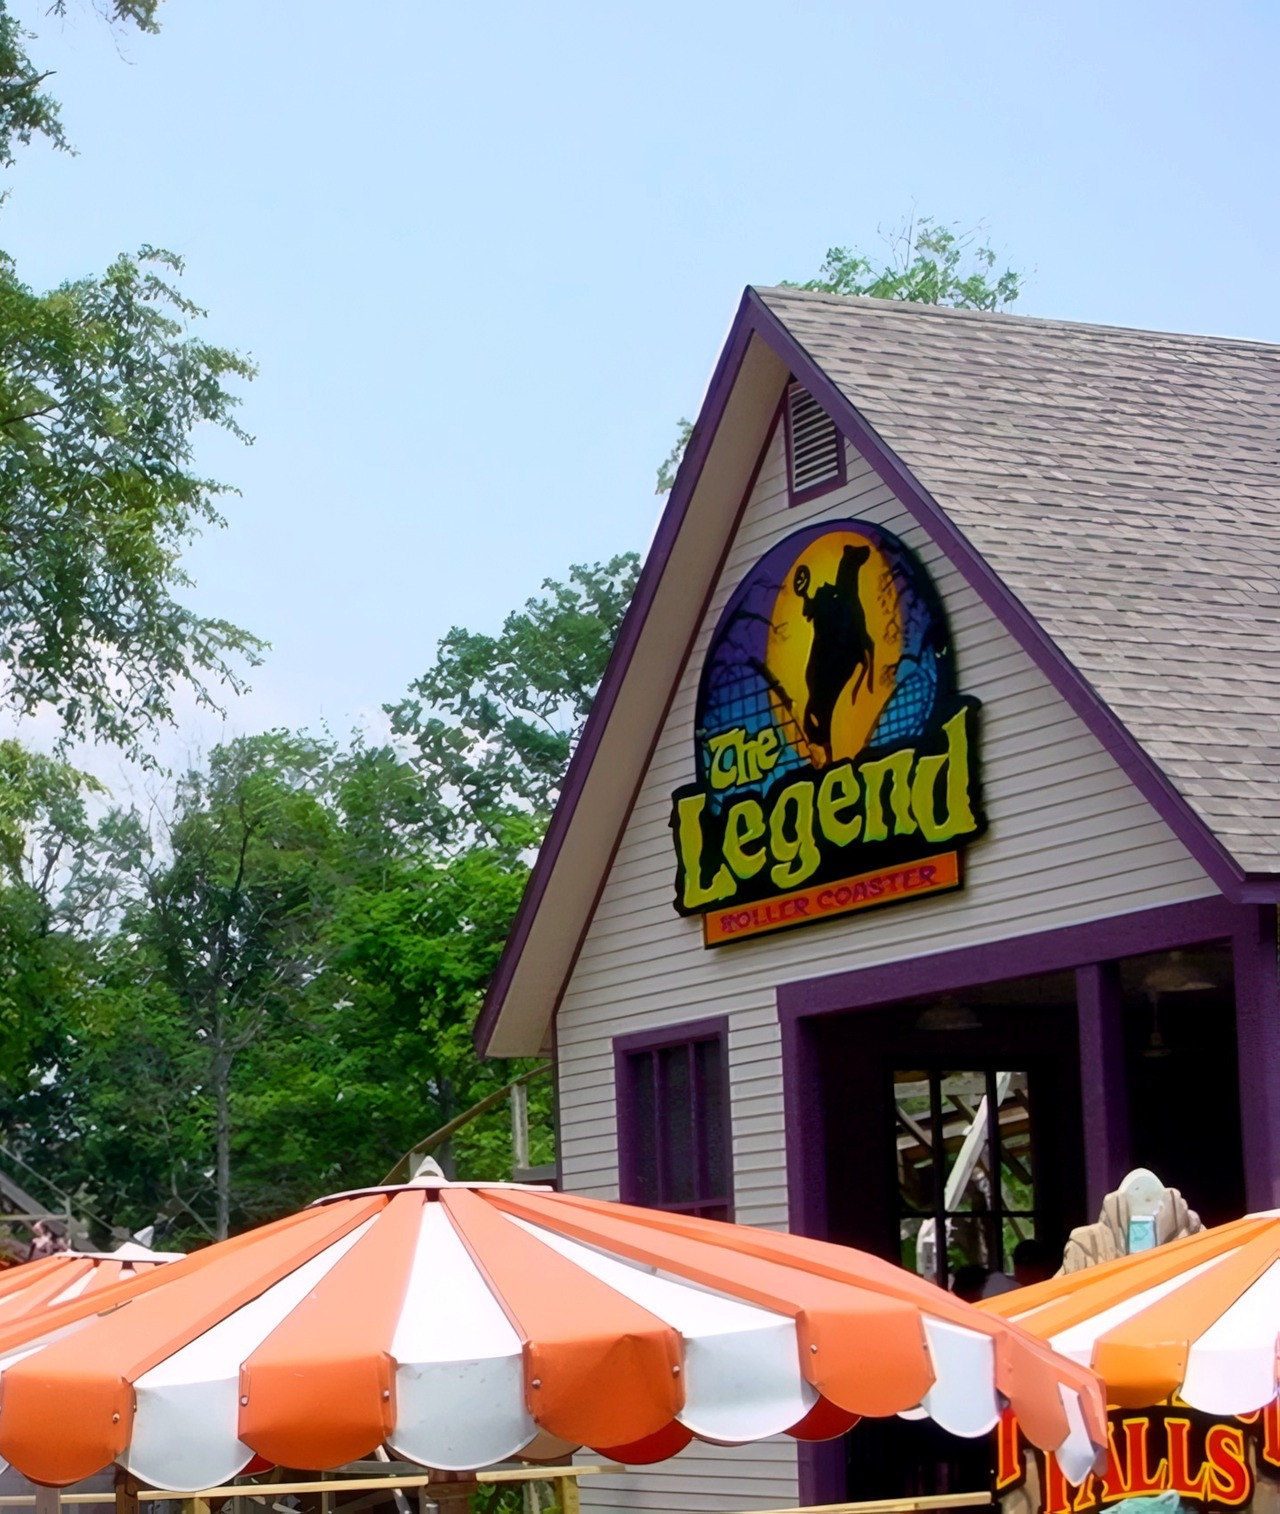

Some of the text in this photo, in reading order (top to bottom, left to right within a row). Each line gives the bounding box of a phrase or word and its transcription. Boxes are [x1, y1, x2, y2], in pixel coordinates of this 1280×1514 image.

[707, 728, 781, 789] The
[677, 706, 978, 908] Legend
[721, 864, 939, 933] ROLLER COASTER
